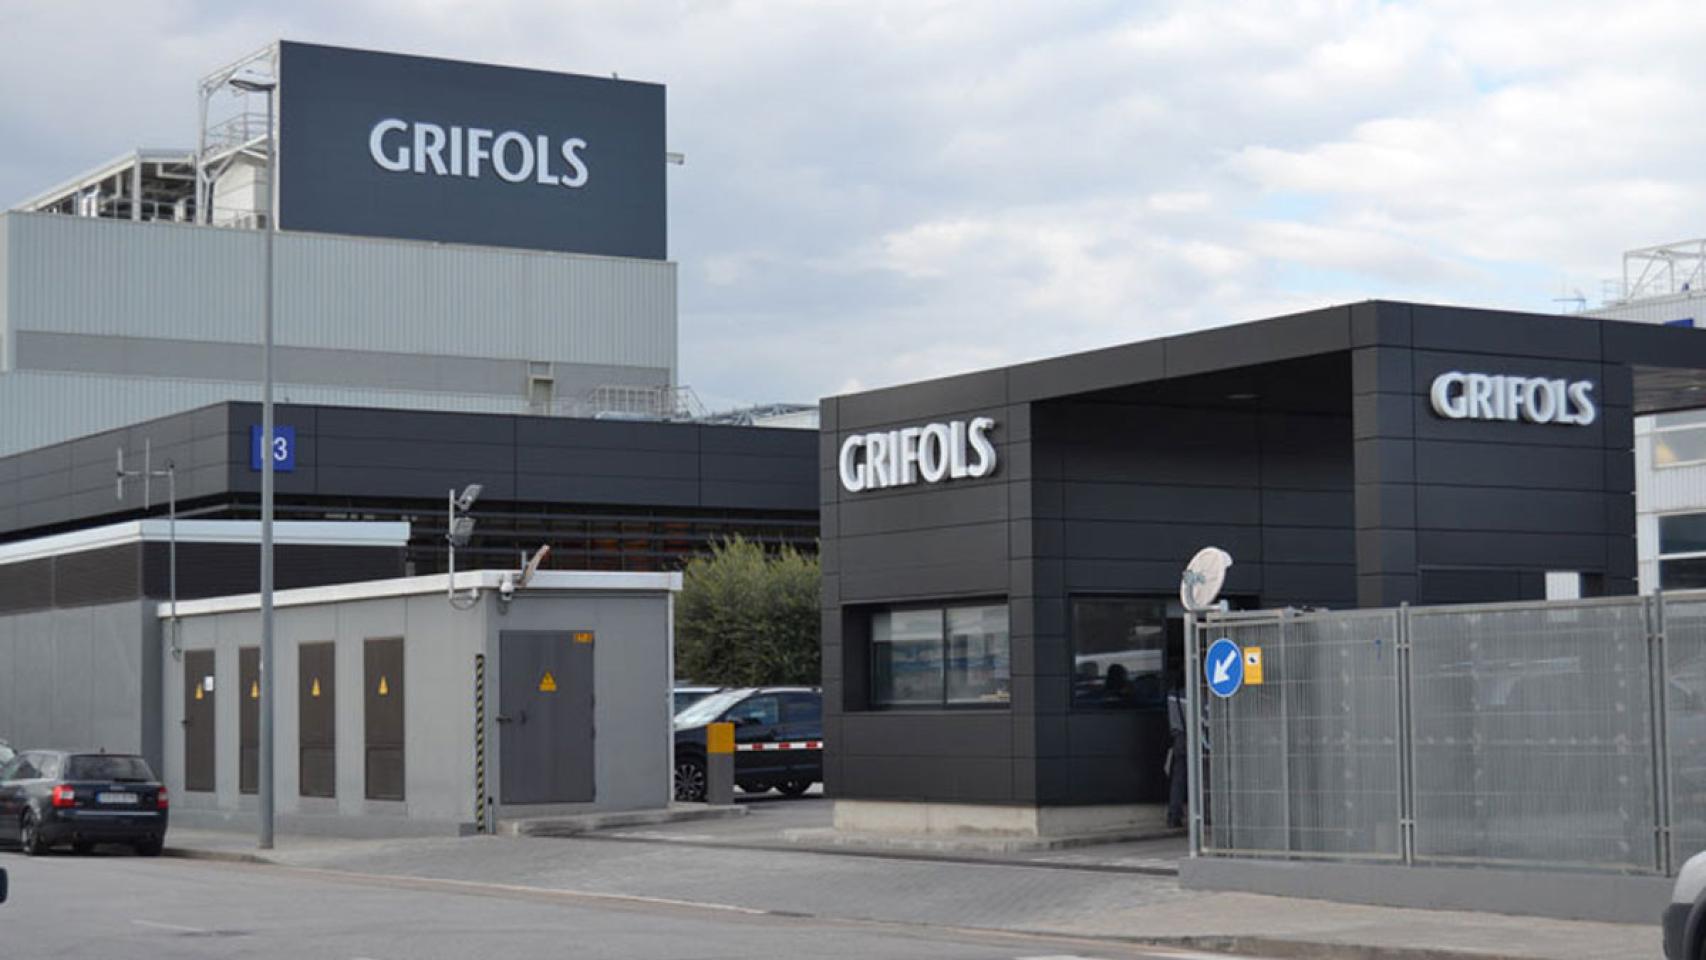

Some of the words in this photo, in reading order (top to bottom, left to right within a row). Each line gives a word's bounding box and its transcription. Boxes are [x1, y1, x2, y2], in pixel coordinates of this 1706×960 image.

[369, 118, 588, 187] GRIFOLS
[1430, 371, 1595, 425] GRIFOLS
[839, 417, 996, 492] GRIFOLS
